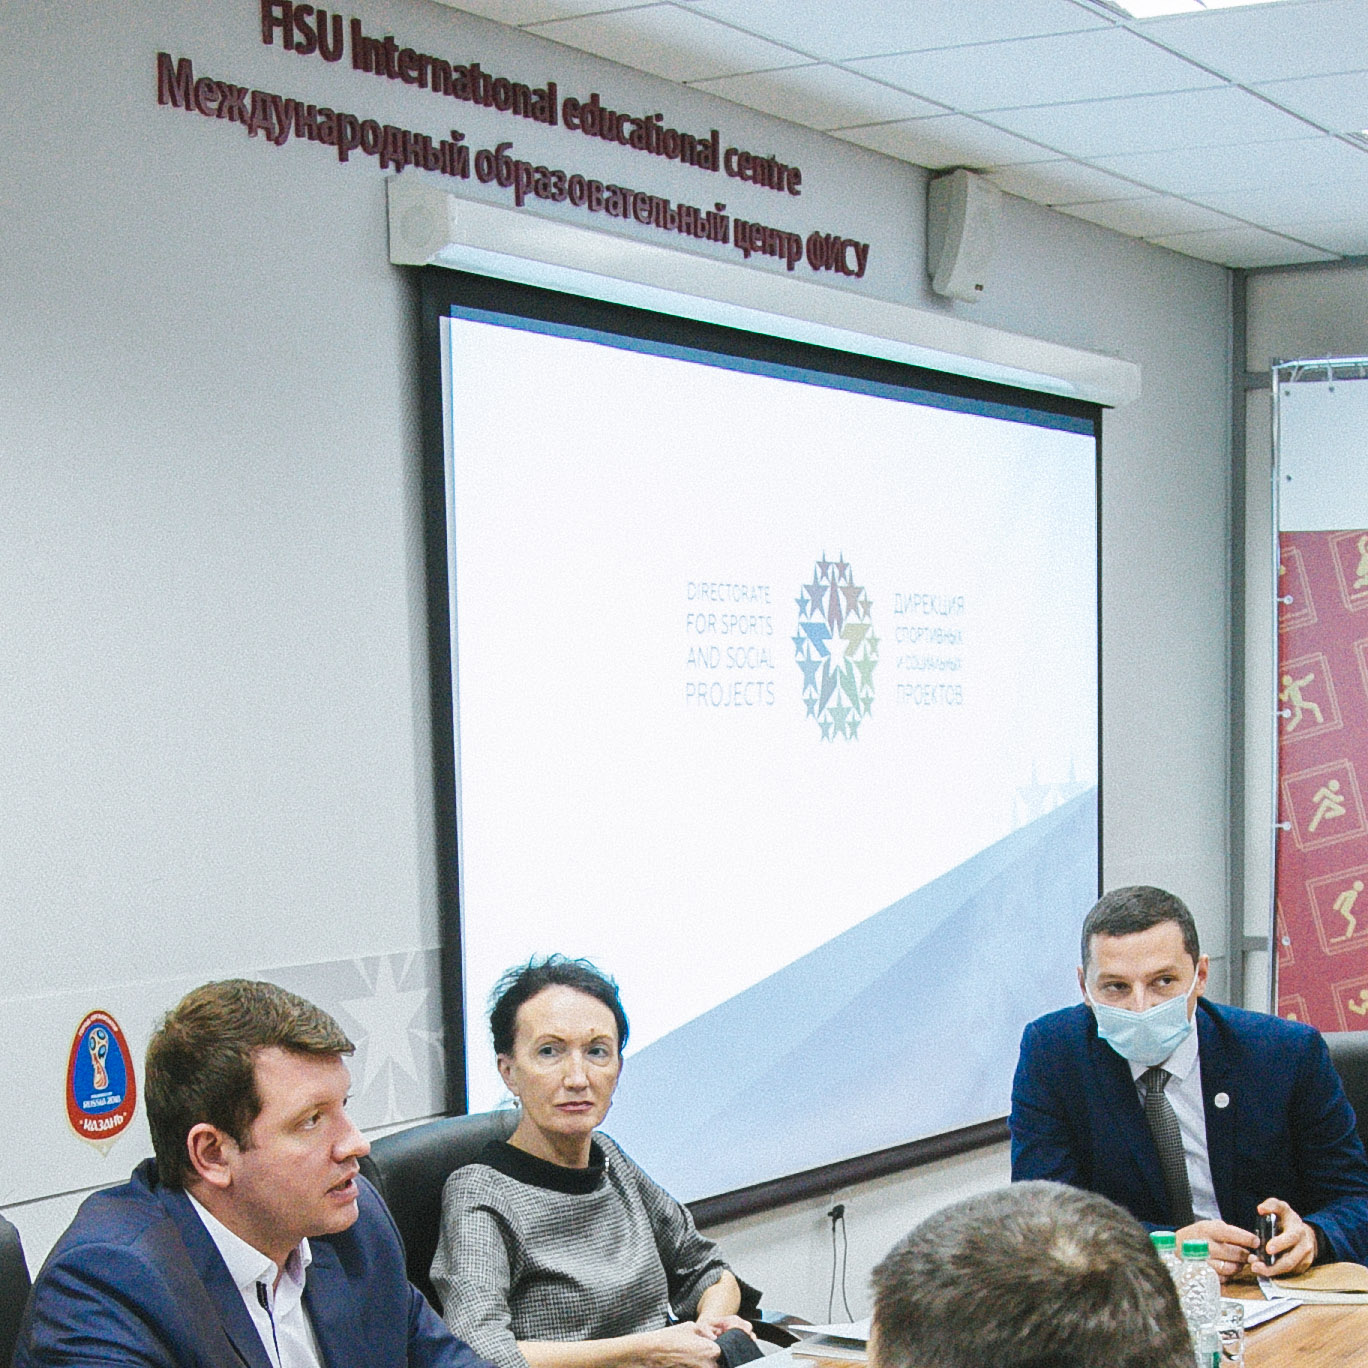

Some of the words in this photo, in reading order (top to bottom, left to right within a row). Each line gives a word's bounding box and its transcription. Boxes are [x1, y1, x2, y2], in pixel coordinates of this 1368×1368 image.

[261, 0, 343, 62] FISU
[351, 18, 557, 125] International
[562, 94, 721, 174] educational
[723, 144, 802, 196] centre
[156, 52, 470, 180] Международный
[475, 142, 730, 244] образовательный
[734, 218, 803, 271] центр
[806, 231, 869, 278] ФИСУ
[687, 581, 772, 604] DIRECTORATE
[686, 613, 717, 634] FOR
[721, 614, 774, 636] SPORTS
[687, 646, 721, 669] AND
[726, 646, 775, 669] SOCIAL
[686, 681, 775, 707] PROJECTS
[83, 1114, 124, 1132] КАЗАНЬ
